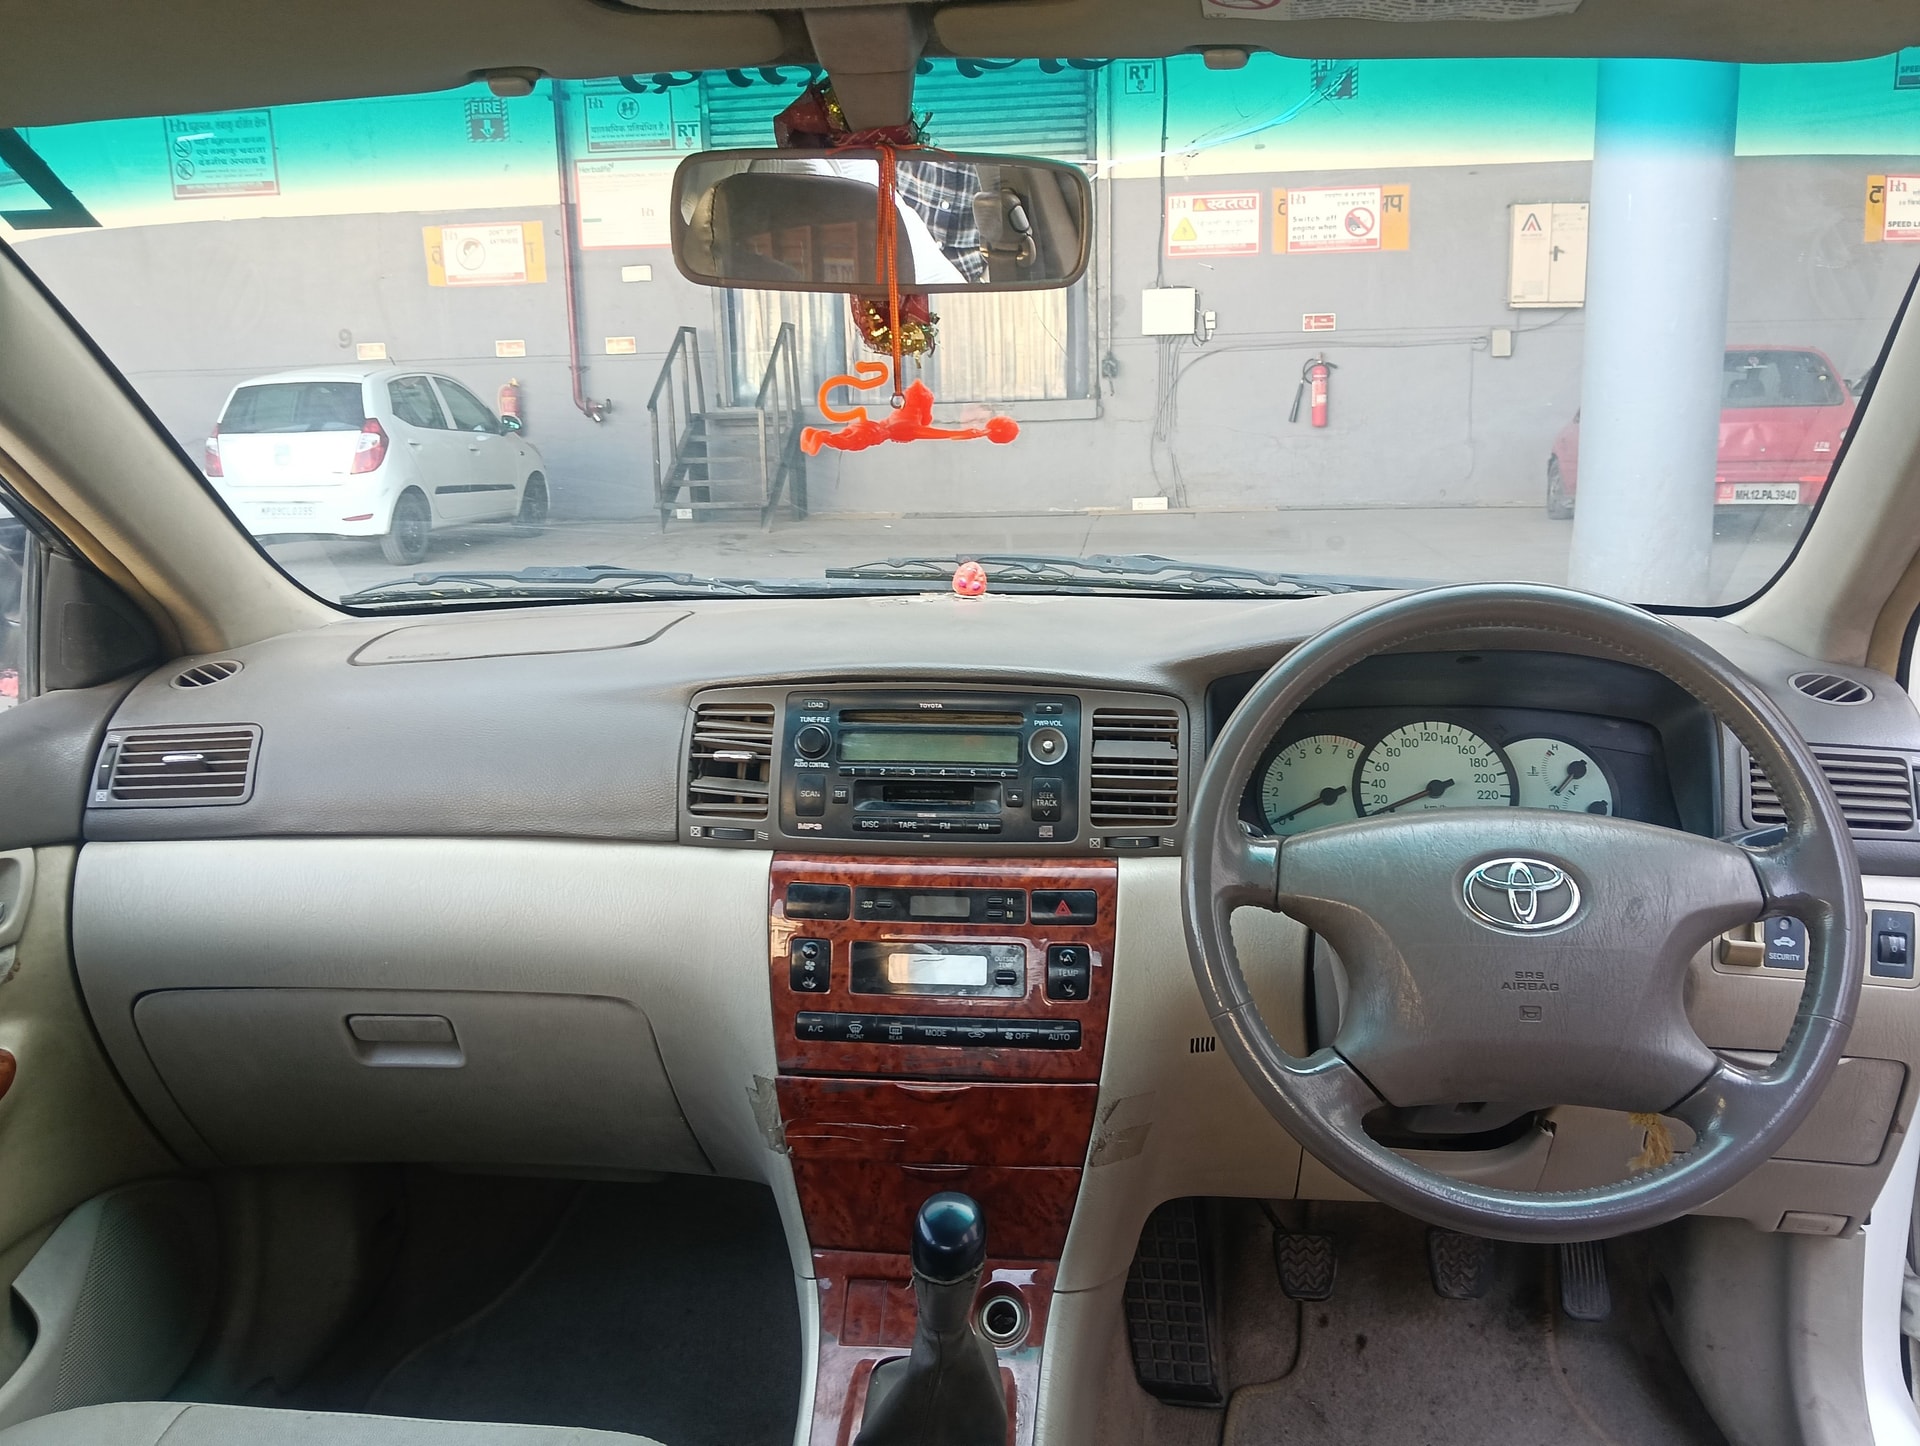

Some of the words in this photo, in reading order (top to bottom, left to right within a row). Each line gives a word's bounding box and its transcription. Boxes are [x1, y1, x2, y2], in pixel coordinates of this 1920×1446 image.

[1129, 65, 1153, 80] RT
[471, 101, 501, 114] FIRE
[677, 124, 698, 137] RT
[339, 329, 352, 348] 9
[1420, 732, 1438, 741] 120
[1440, 735, 1458, 745] 140
[1400, 738, 1419, 748] 100
[1300, 749, 1306, 759] 5
[1315, 745, 1322, 754] 6
[1332, 745, 1339, 754] 7
[1347, 749, 1354, 759] 8
[1386, 748, 1400, 757] 80
[1457, 745, 1476, 755] 160
[1284, 758, 1292, 767] 4
[1375, 762, 1389, 772] 60
[1469, 758, 1488, 767] 180
[1276, 772, 1283, 781] 3
[1474, 773, 1496, 783] 200
[1371, 779, 1386, 788] 40
[1272, 787, 1279, 796] 2
[1477, 790, 1499, 800] 220
[1373, 795, 1388, 804] 20
[1273, 803, 1277, 812] 1
[899, 821, 917, 829] TAPE
[1769, 952, 1800, 961] SECURITY
[1058, 969, 1079, 977] TEMP
[1515, 971, 1544, 979] SRS
[1501, 982, 1559, 991] AIRBAG
[925, 1029, 947, 1037] MODE
